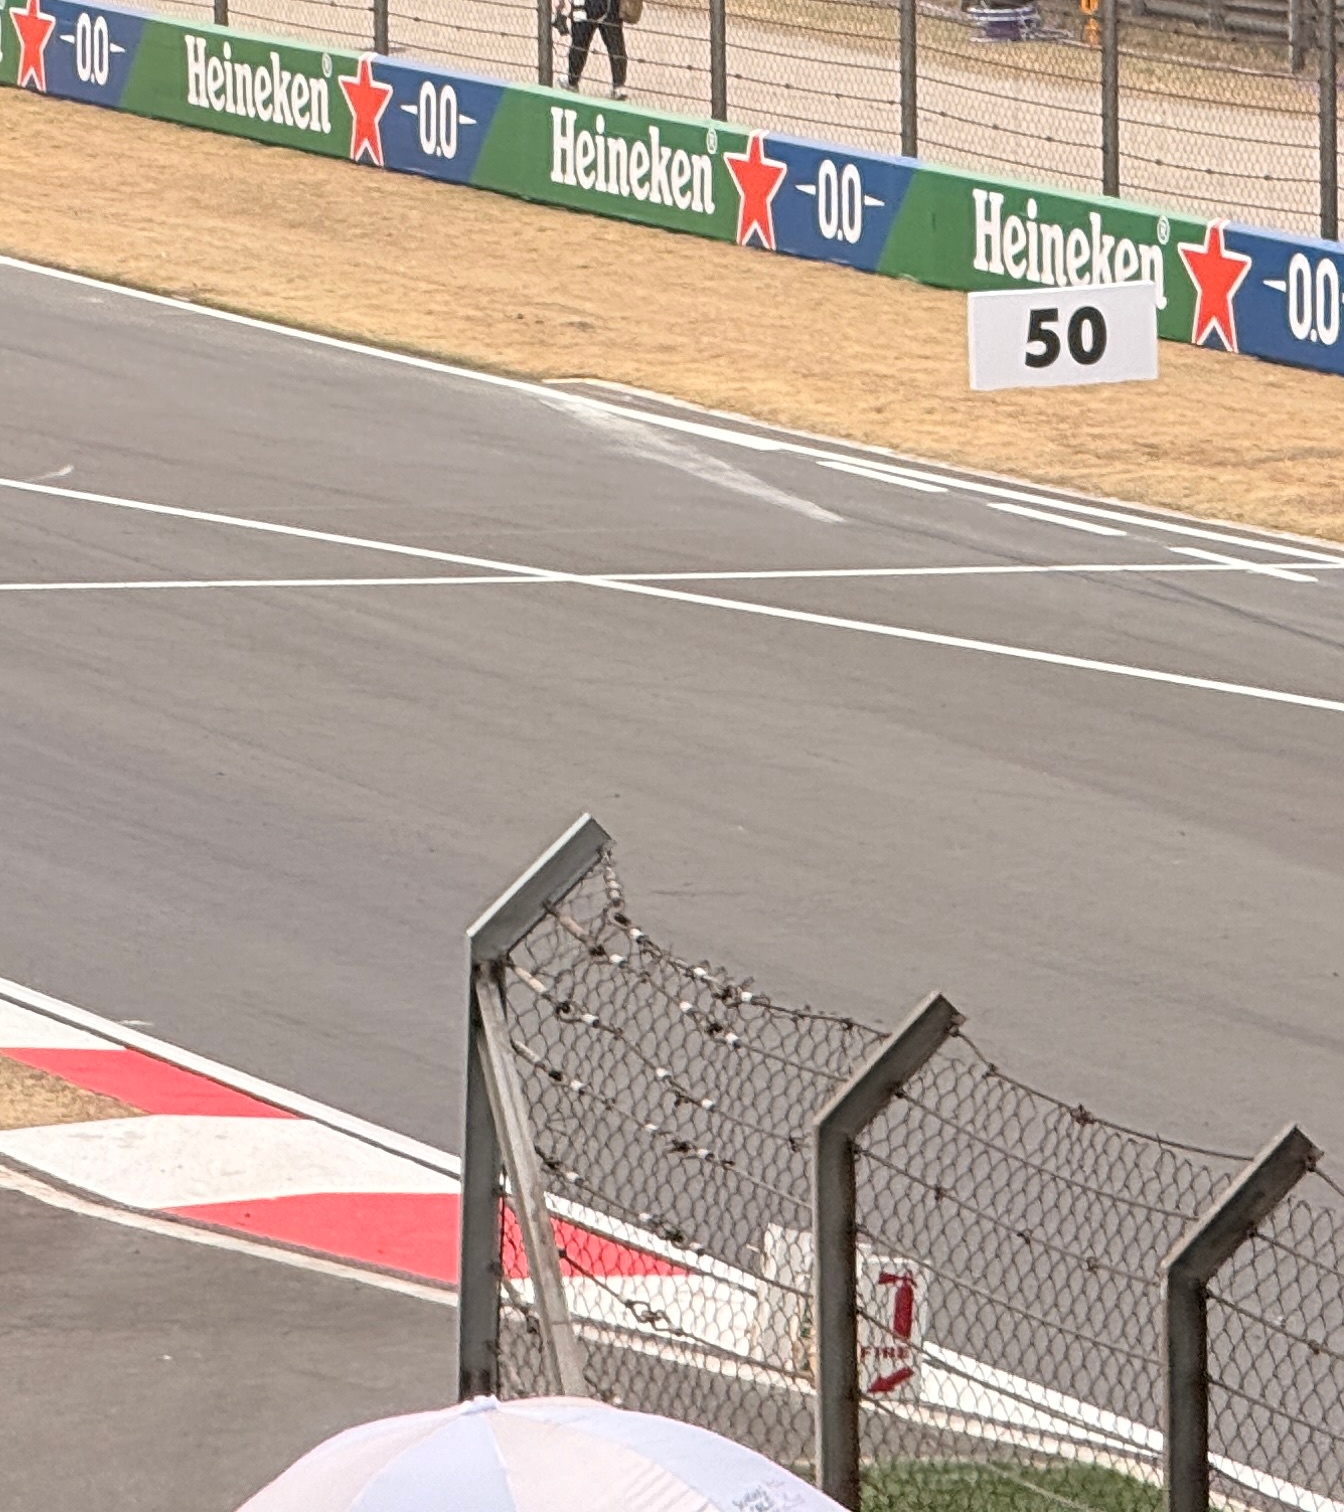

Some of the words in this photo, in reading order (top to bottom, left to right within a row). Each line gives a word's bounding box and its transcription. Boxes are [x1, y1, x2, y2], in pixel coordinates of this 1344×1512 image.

[184, 34, 332, 135] Heineken
[550, 105, 716, 215] Heineken
[1024, 305, 1108, 368] 50
[860, 1346, 910, 1359] FIRE
